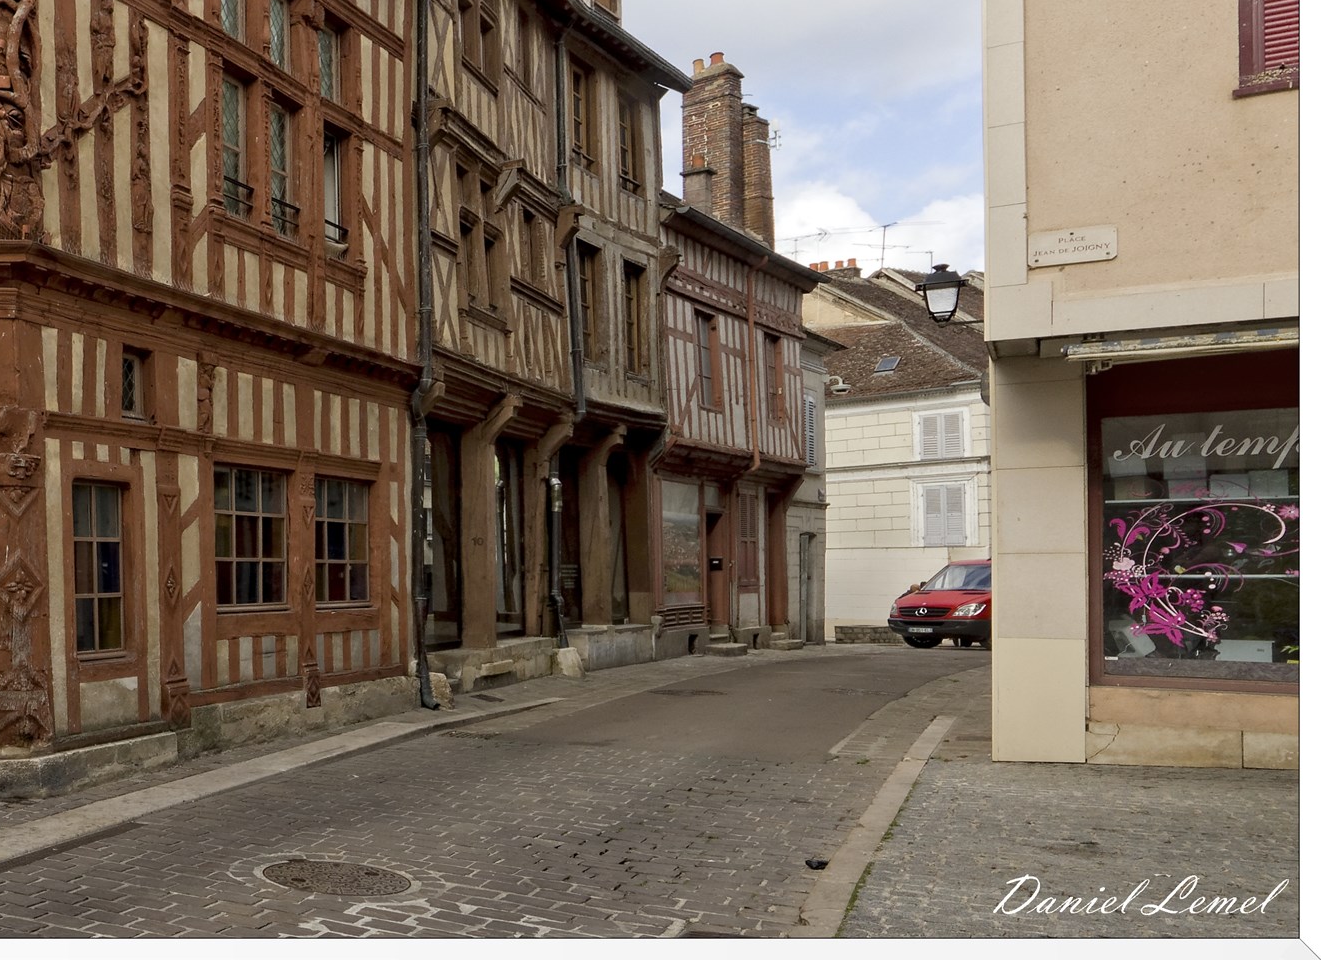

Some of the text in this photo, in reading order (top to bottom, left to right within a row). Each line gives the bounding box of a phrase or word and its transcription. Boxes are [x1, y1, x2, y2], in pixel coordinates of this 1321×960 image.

[1058, 236, 1086, 244] PLACE
[1033, 249, 1056, 257] JEAN
[1072, 243, 1110, 253] JOIGNY
[1113, 423, 1195, 462] Au
